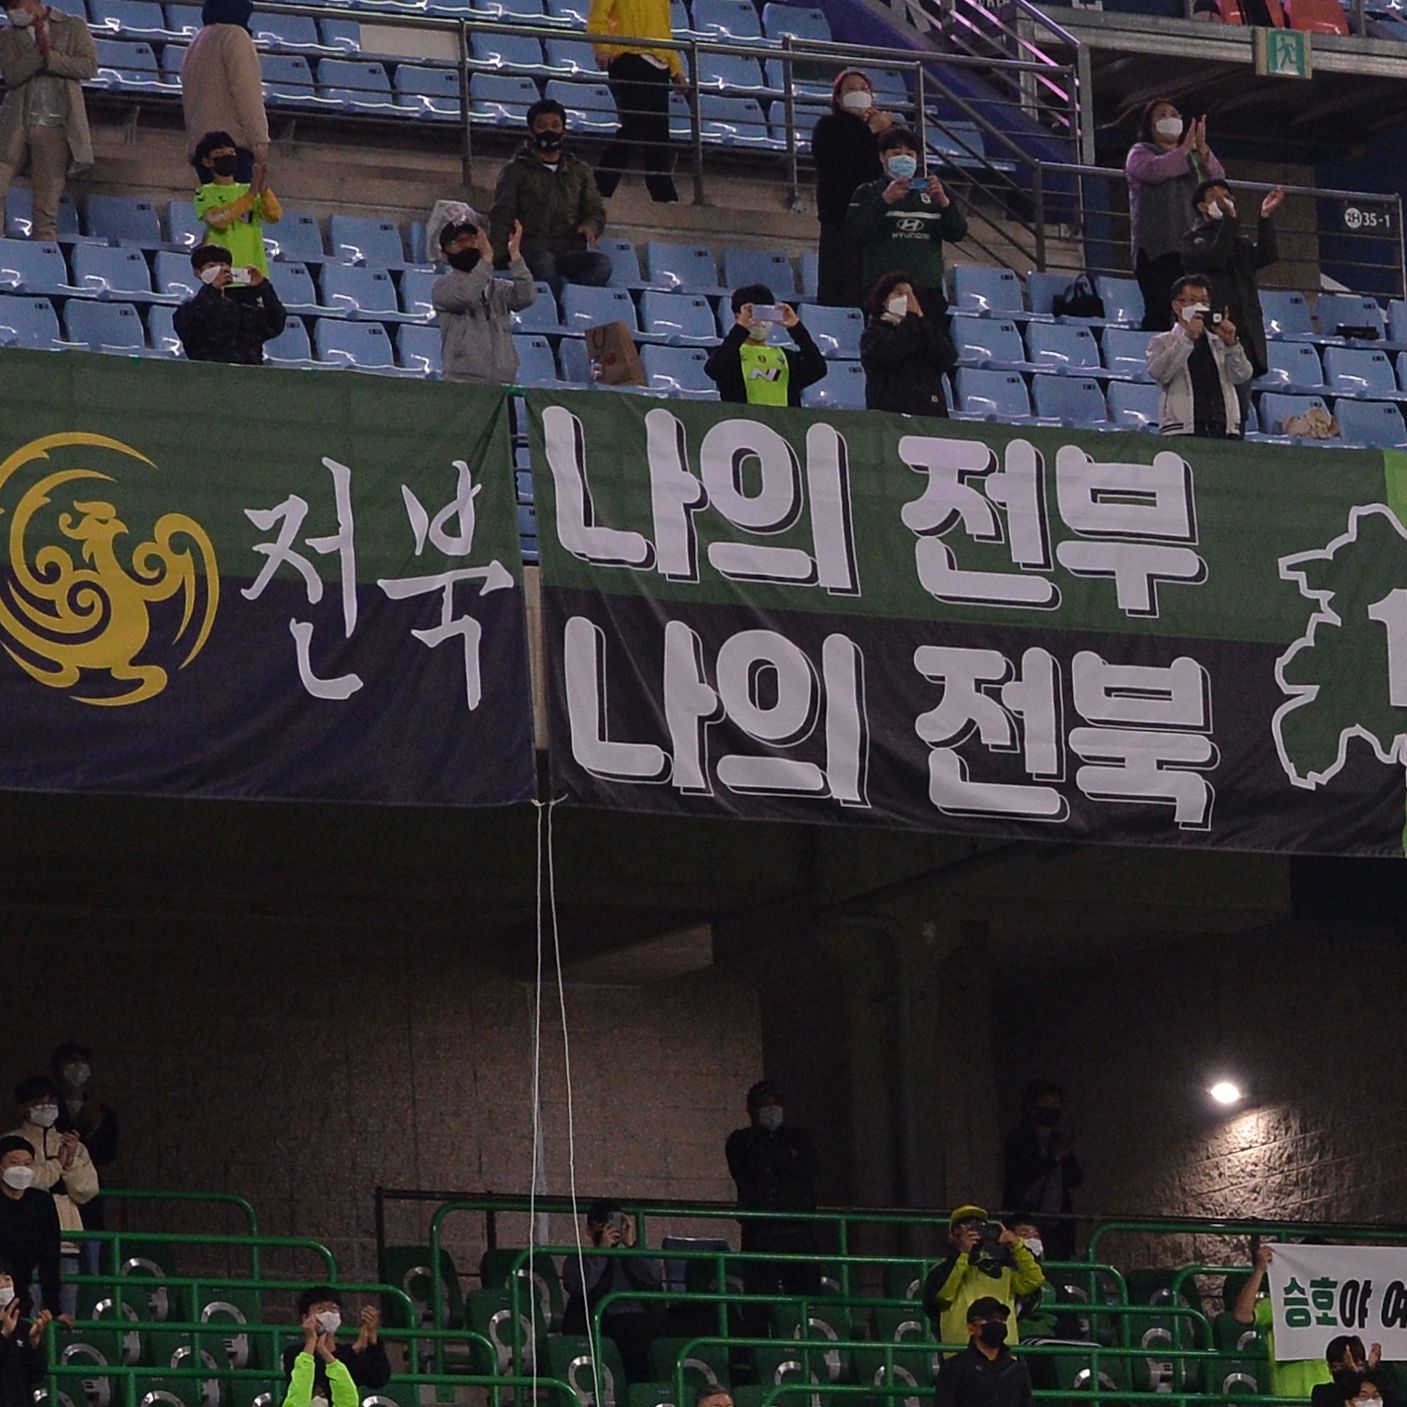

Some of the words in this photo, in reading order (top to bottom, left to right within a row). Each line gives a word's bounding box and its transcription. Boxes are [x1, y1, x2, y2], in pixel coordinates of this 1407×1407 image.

[1363, 212, 1390, 228] 35-1
[241, 456, 516, 712] 전북
[541, 406, 862, 598] 나의
[897, 435, 1208, 619] 전부
[565, 615, 872, 809] 나의
[914, 646, 1220, 831] 전북
[1283, 1276, 1371, 1329] 승호야
